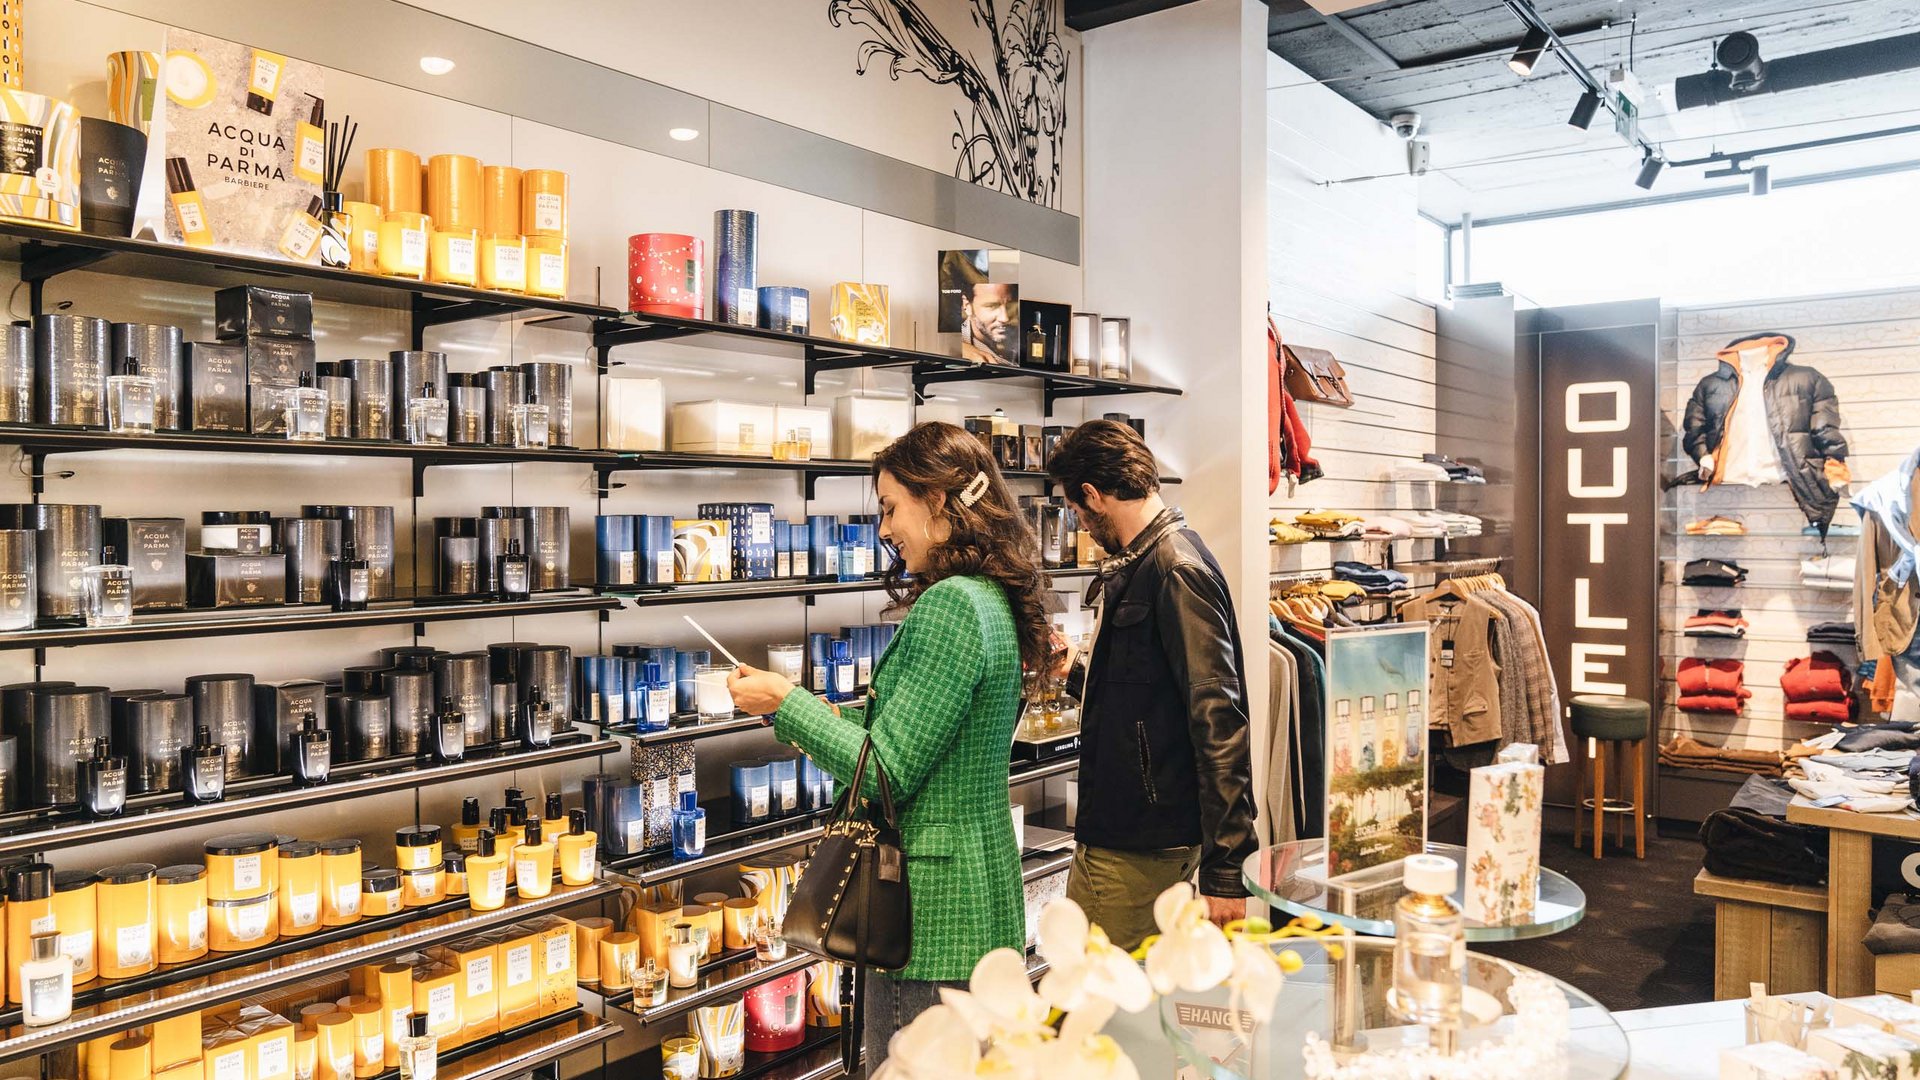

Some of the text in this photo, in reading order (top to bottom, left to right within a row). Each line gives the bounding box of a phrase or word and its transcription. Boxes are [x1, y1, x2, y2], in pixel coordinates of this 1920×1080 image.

[208, 122, 286, 150] ACQUA
[7, 137, 35, 145] ACQUA
[7, 145, 35, 154] PARMA
[240, 147, 254, 158] DI
[207, 153, 286, 182] PARMA
[224, 175, 270, 190] BARBIERE
[141, 366, 168, 374] ACQUA
[290, 698, 312, 706] ACQUA
[223, 720, 246, 728] ACQUA
[471, 960, 489, 968] ACQUA
[34, 986, 59, 994] PARMA
